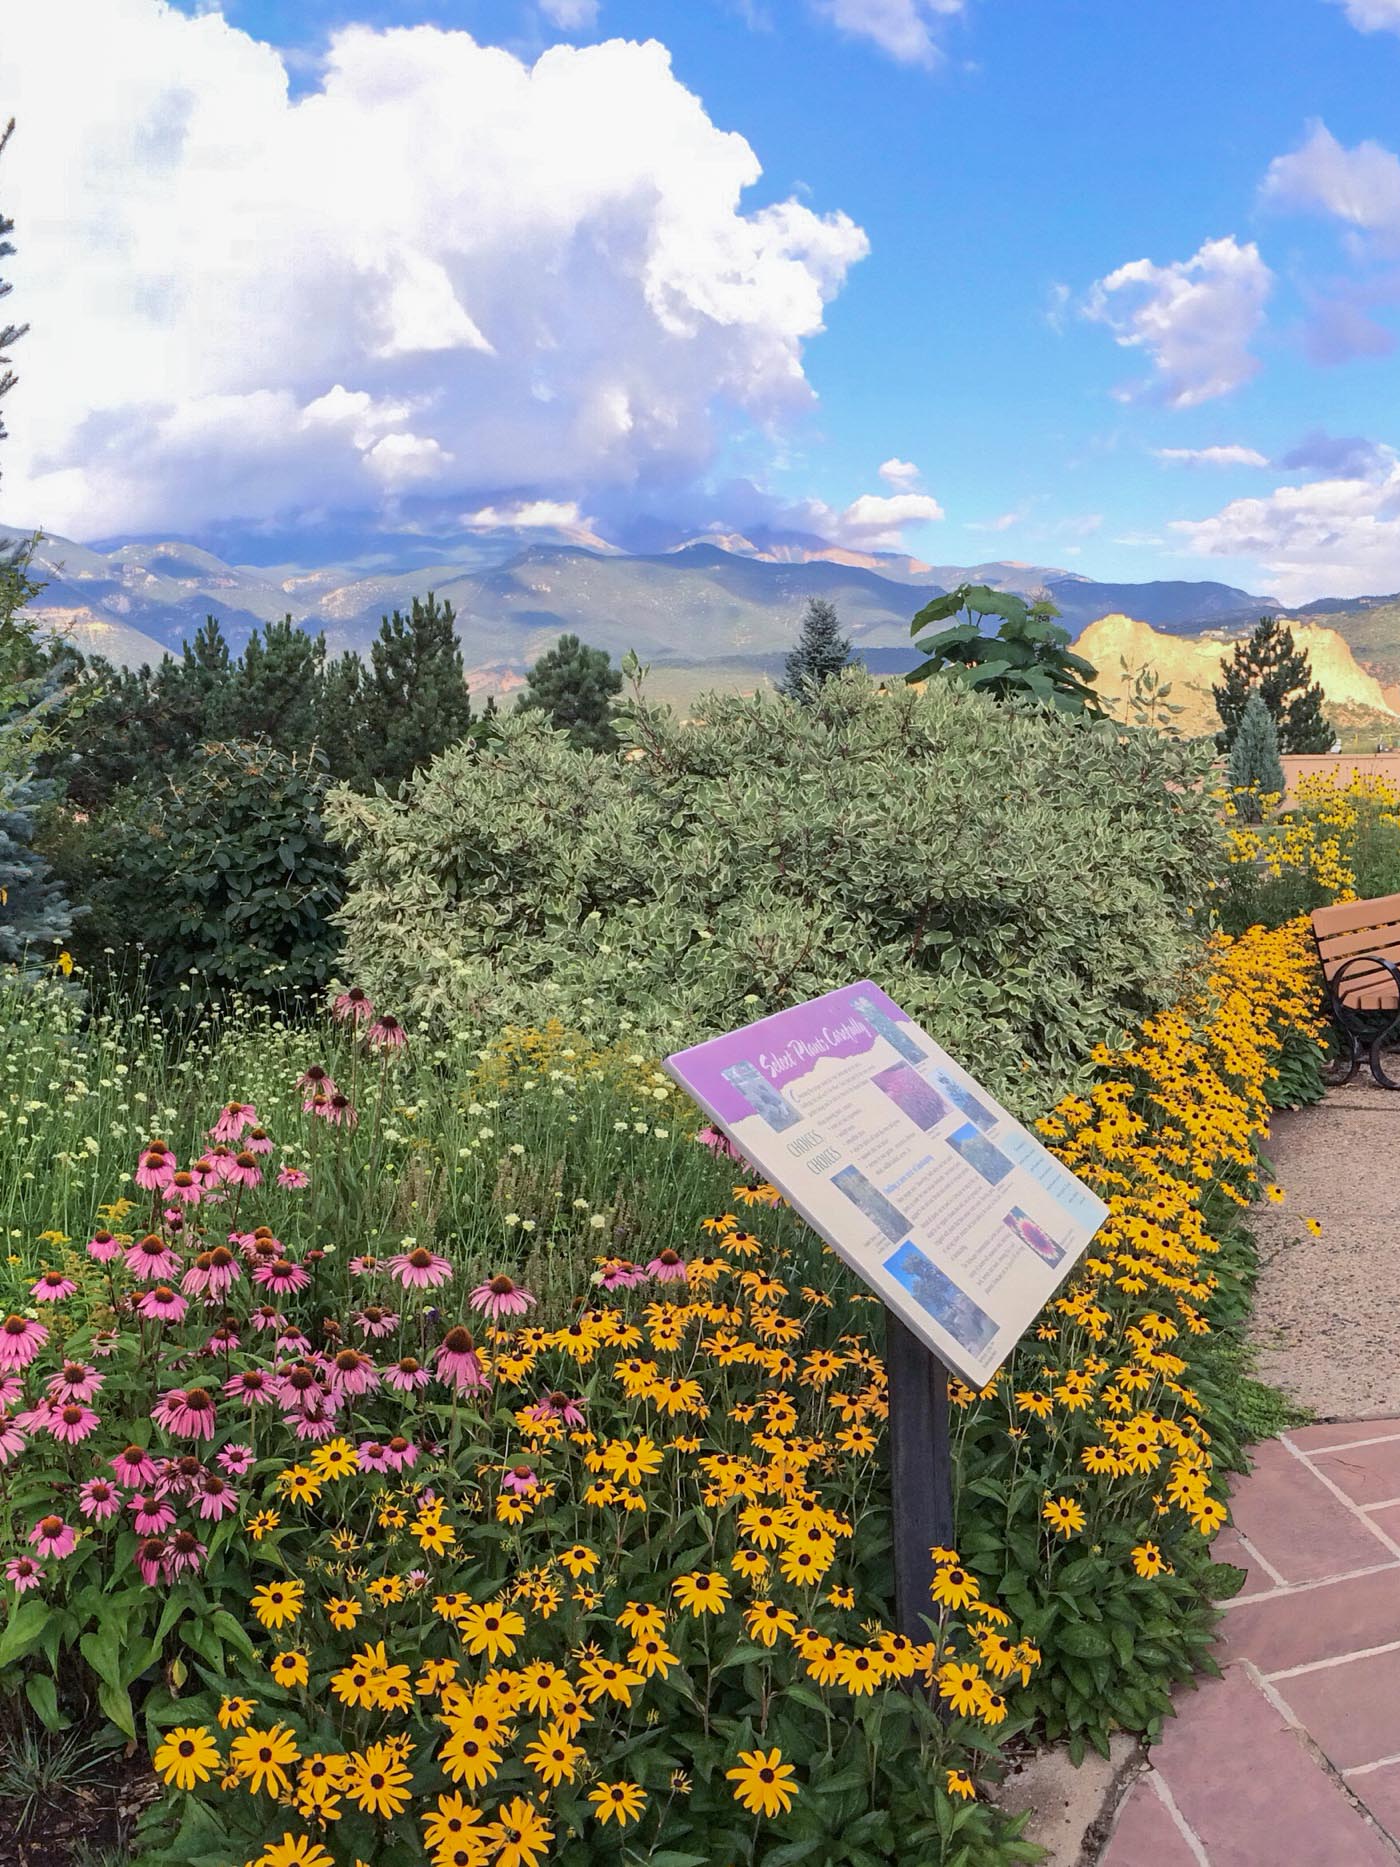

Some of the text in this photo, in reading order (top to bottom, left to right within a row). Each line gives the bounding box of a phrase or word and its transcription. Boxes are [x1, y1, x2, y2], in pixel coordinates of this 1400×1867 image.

[759, 1016, 872, 1078] Select Plants Carefully
[786, 1129, 824, 1158] CHOICES
[806, 1146, 842, 1175] CHOICES
